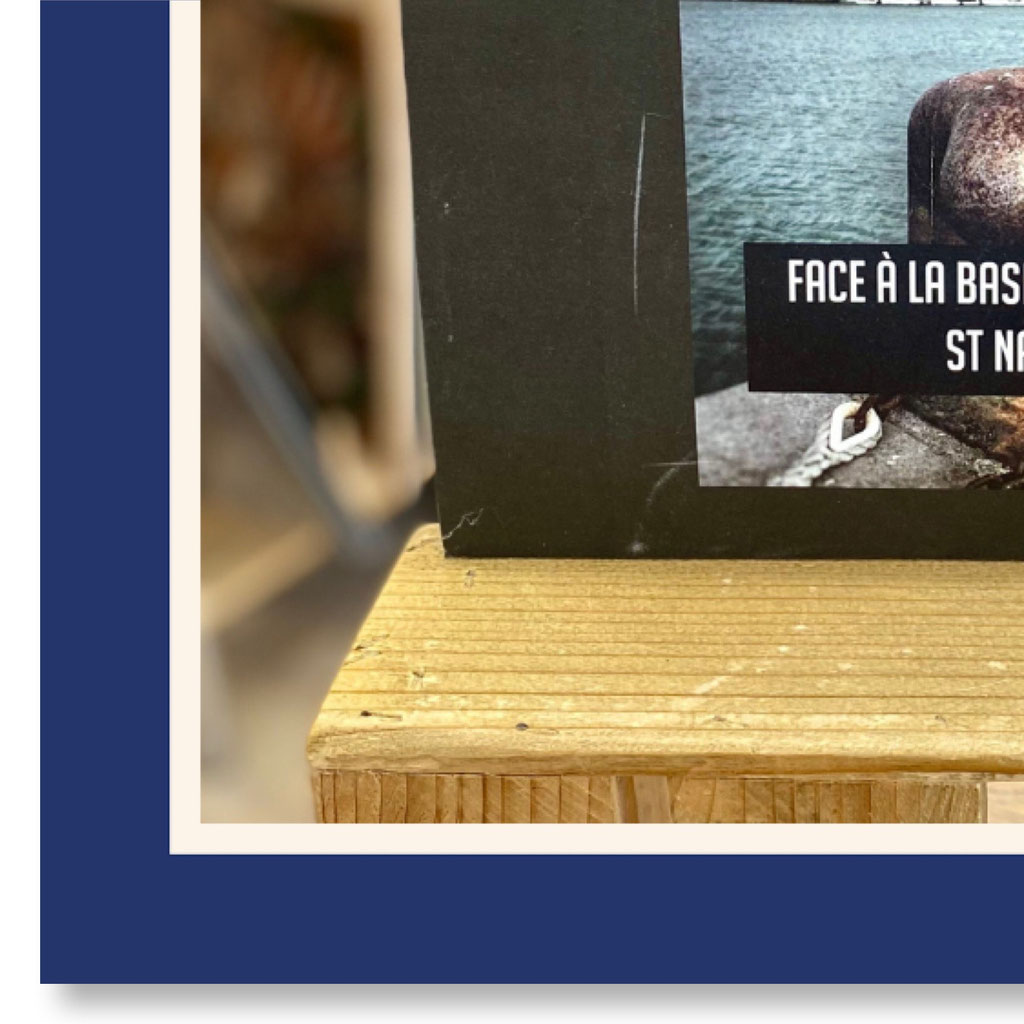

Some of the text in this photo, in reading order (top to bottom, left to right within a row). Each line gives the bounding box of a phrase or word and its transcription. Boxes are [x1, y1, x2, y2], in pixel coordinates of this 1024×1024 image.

[787, 260, 866, 303] FACE
[876, 251, 898, 304] À
[908, 262, 946, 305] LA
[946, 330, 984, 372] ST
